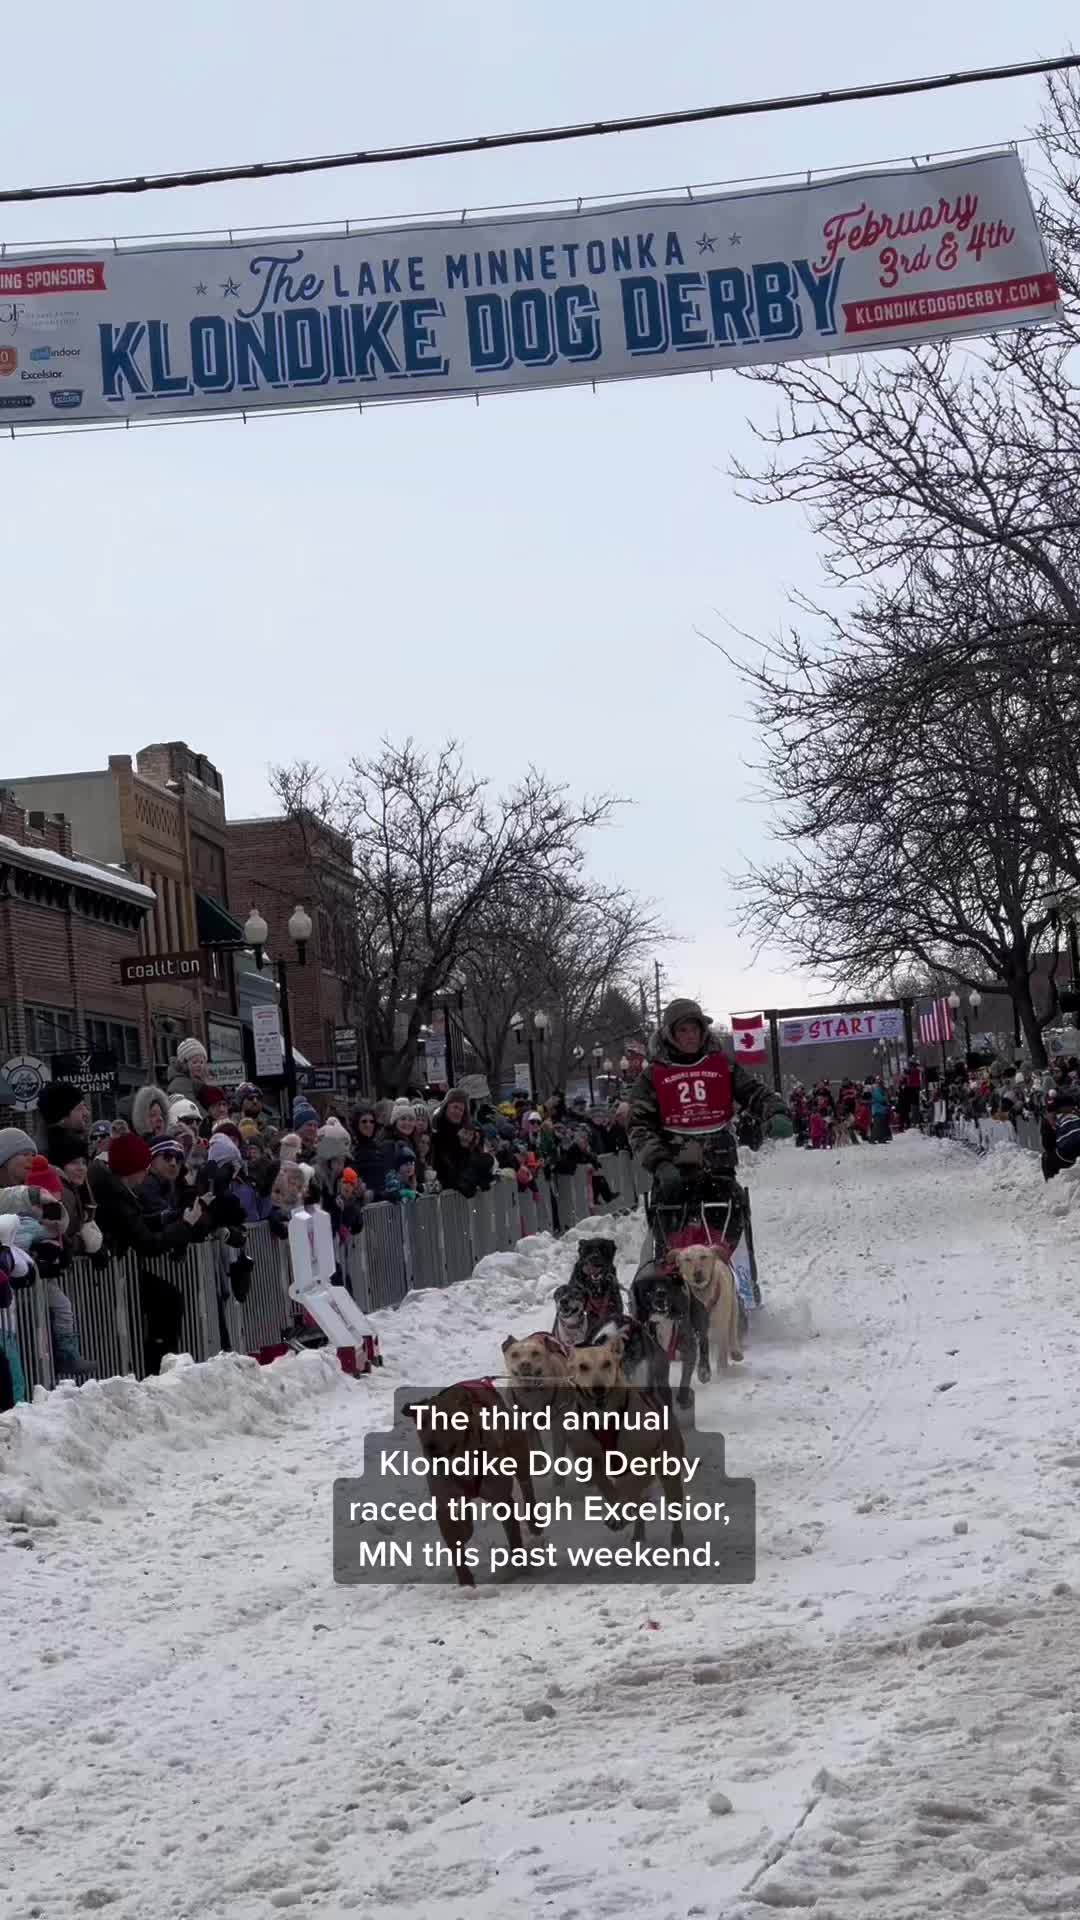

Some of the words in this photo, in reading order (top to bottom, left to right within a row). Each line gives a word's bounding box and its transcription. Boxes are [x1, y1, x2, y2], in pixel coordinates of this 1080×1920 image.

[812, 193, 979, 273] February
[879, 244, 931, 288] 3rd
[936, 231, 959, 271] &
[966, 219, 1016, 262] 4th
[26, 268, 95, 288] SPONSORS
[237, 249, 325, 318] The
[333, 256, 426, 297] LAKE
[445, 231, 685, 289] MINNETONKA
[855, 281, 1041, 325] KLONDIKEDOGDERBY.COM
[98, 298, 450, 401] KLONDIKE
[465, 284, 602, 373] DOG
[620, 257, 845, 356] DERBY
[21, 369, 63, 381] Excelsior
[808, 1015, 876, 1040] START
[677, 1079, 706, 1104] 26
